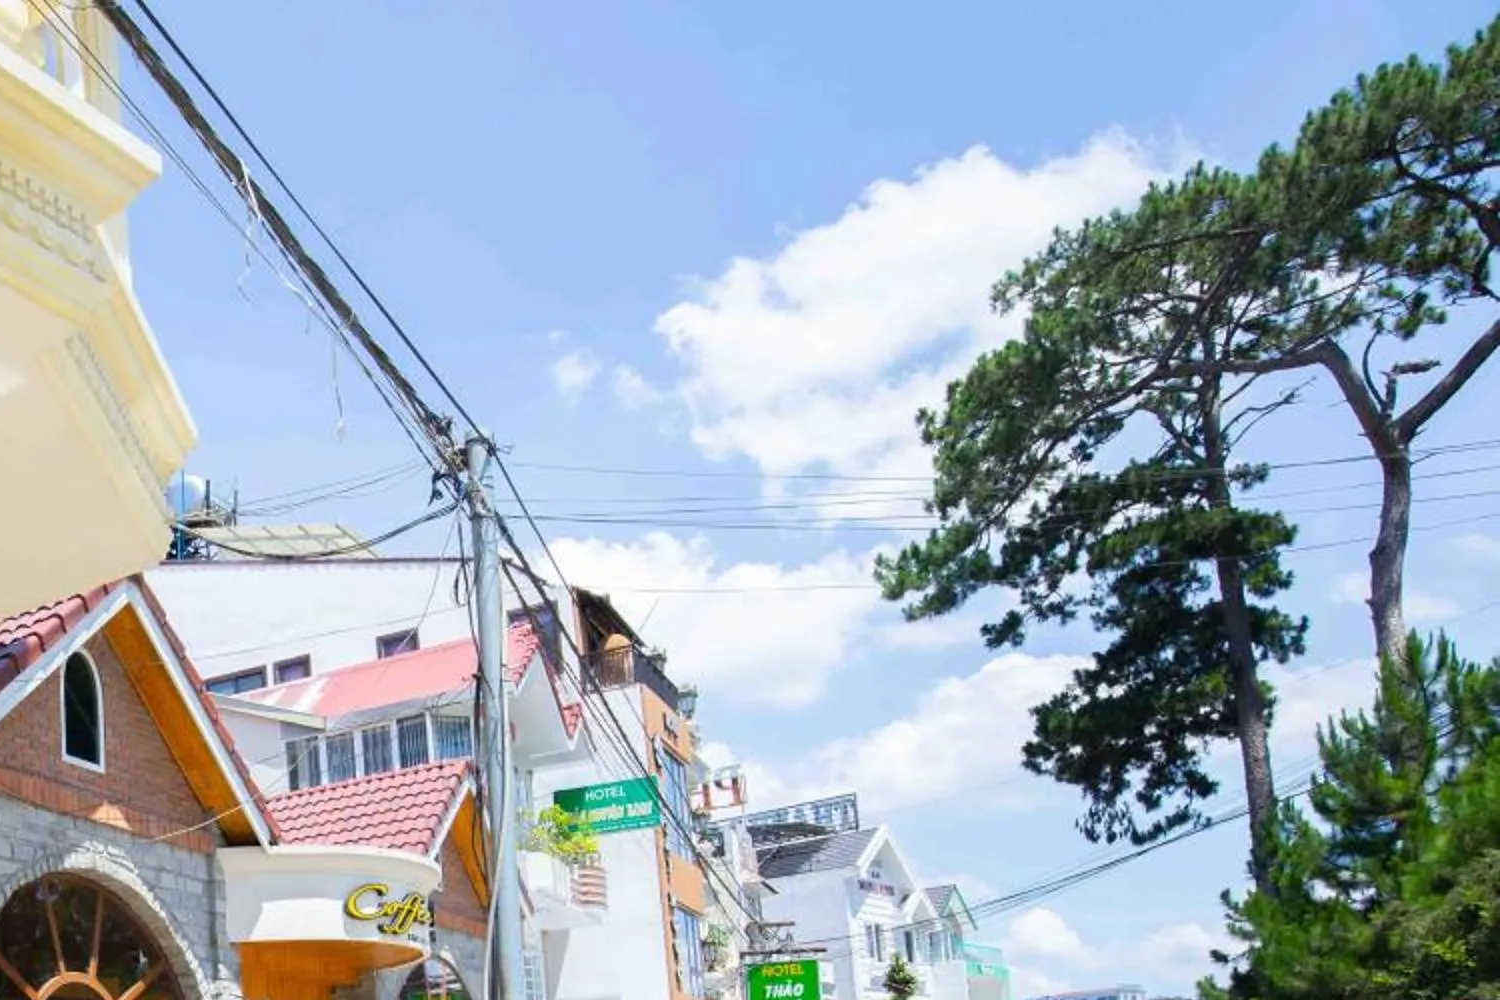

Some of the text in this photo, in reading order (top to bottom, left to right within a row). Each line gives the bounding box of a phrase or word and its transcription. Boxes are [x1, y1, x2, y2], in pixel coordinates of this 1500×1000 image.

[585, 785, 627, 802] HOTEL
[762, 963, 805, 977] HOTEL
[764, 979, 805, 998] THẢO
